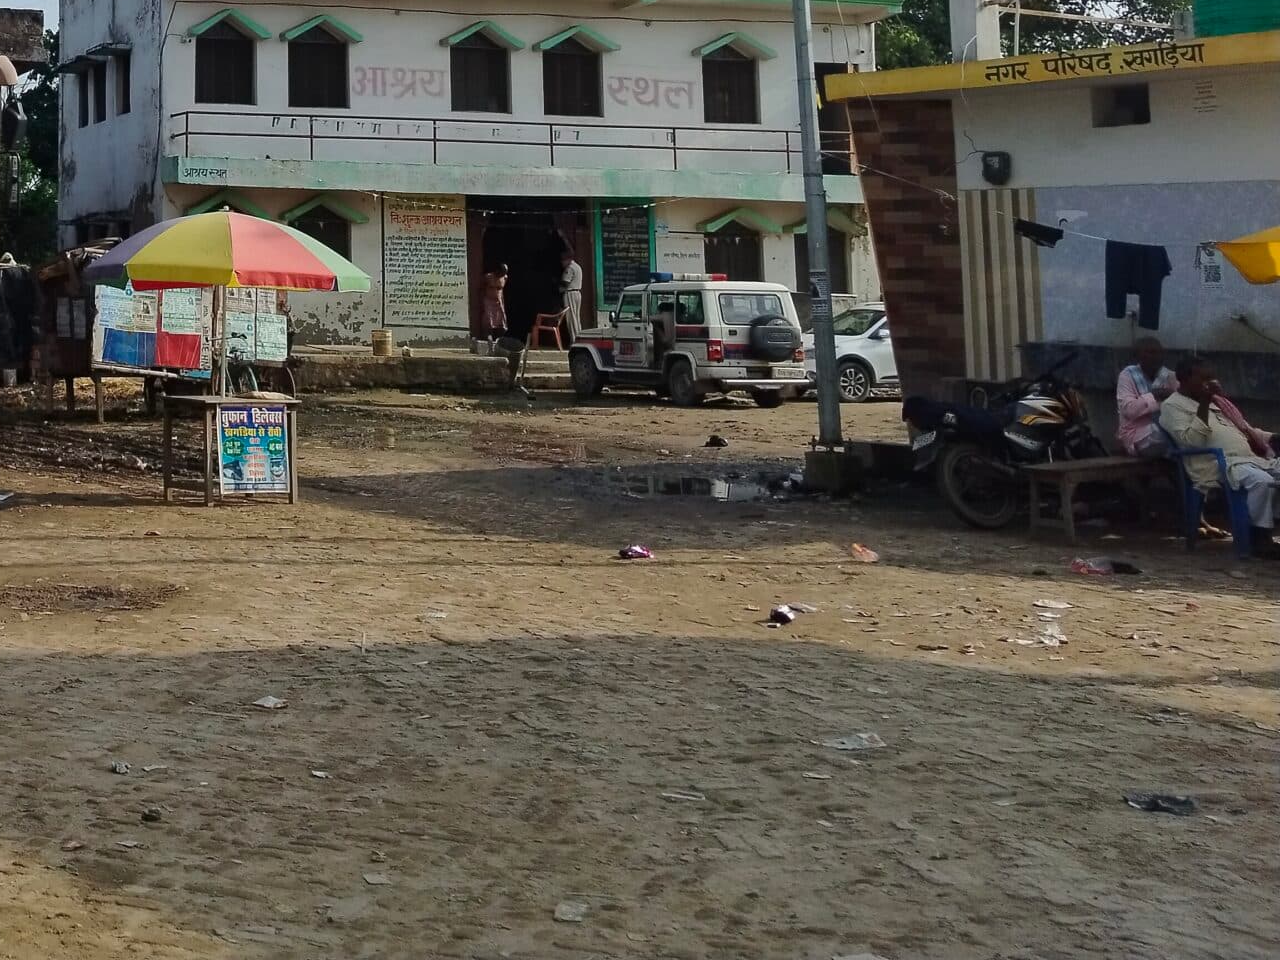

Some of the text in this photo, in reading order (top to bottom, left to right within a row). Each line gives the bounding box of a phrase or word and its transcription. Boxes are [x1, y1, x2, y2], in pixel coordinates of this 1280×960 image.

[985, 61, 1030, 82] नगर
[353, 66, 697, 110] आश्रय स्थल
